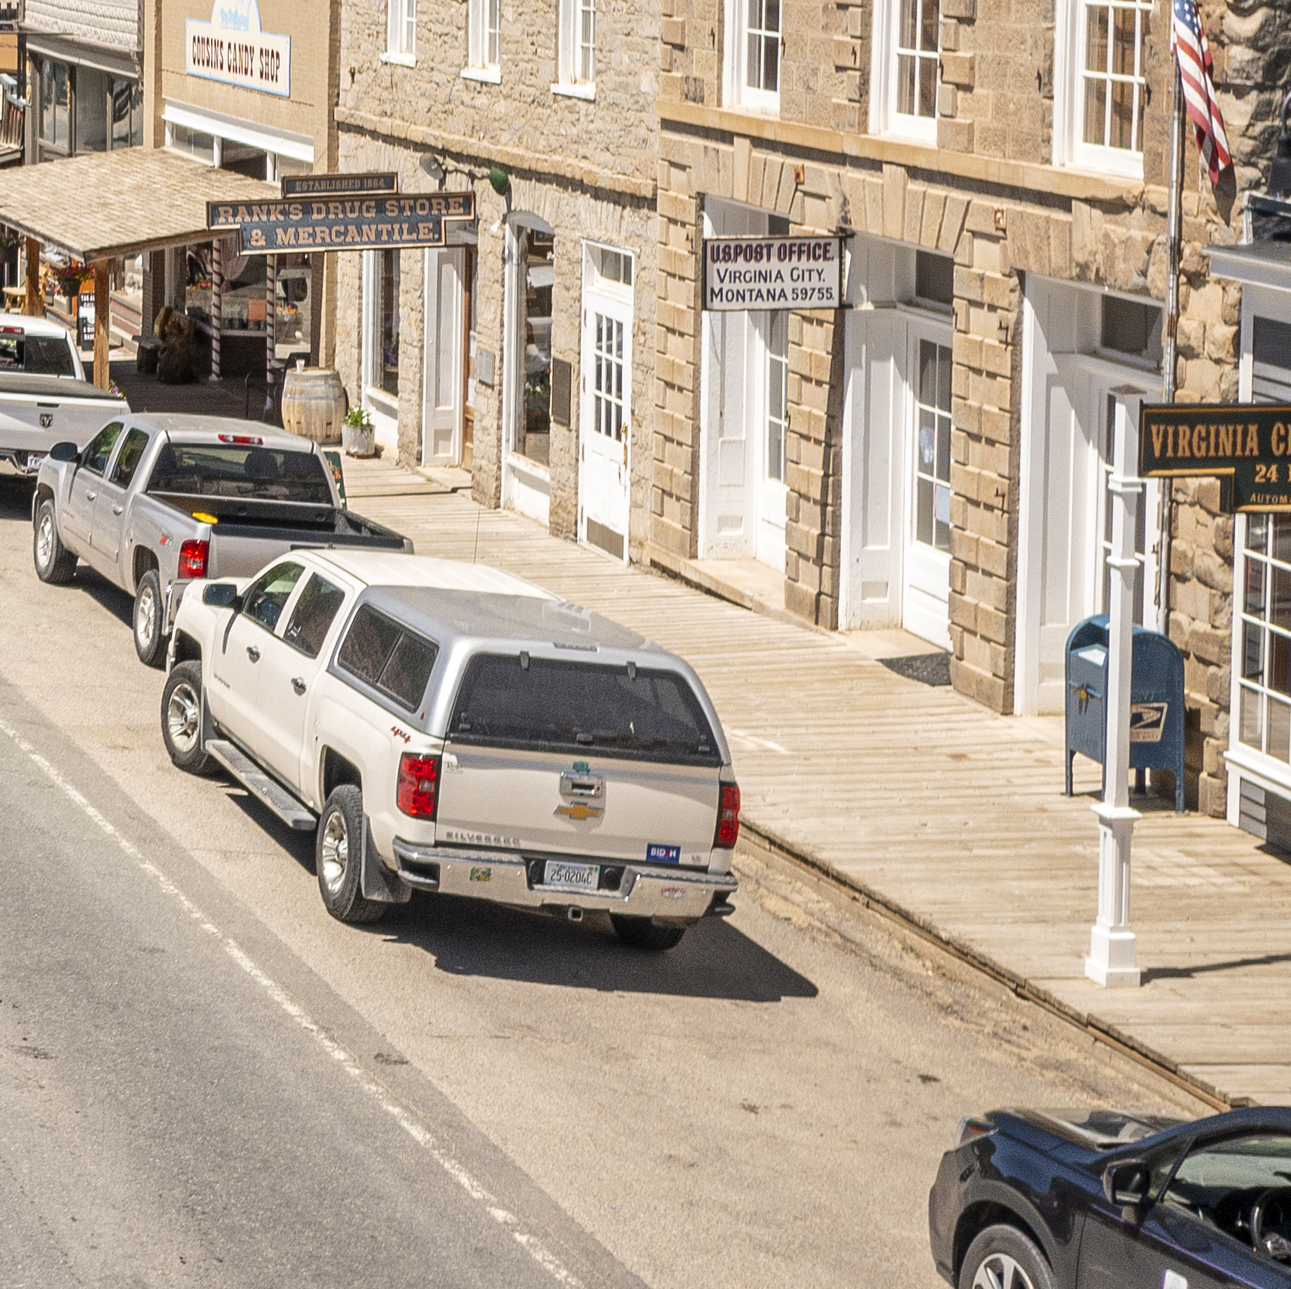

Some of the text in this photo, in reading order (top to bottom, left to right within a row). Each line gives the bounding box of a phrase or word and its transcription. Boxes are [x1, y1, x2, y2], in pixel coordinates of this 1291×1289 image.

[192, 35, 281, 83] COUSINS CANDY SHOP
[295, 179, 361, 192] ESTABLISHED
[218, 197, 464, 224] RANK'S DRUG STORE
[250, 223, 439, 247] & MERCANTILE.
[716, 268, 784, 284] VIRGINIA
[710, 287, 788, 303] MONTANA
[1150, 423, 1260, 458] VIRGINIA
[1254, 464, 1279, 484] 24
